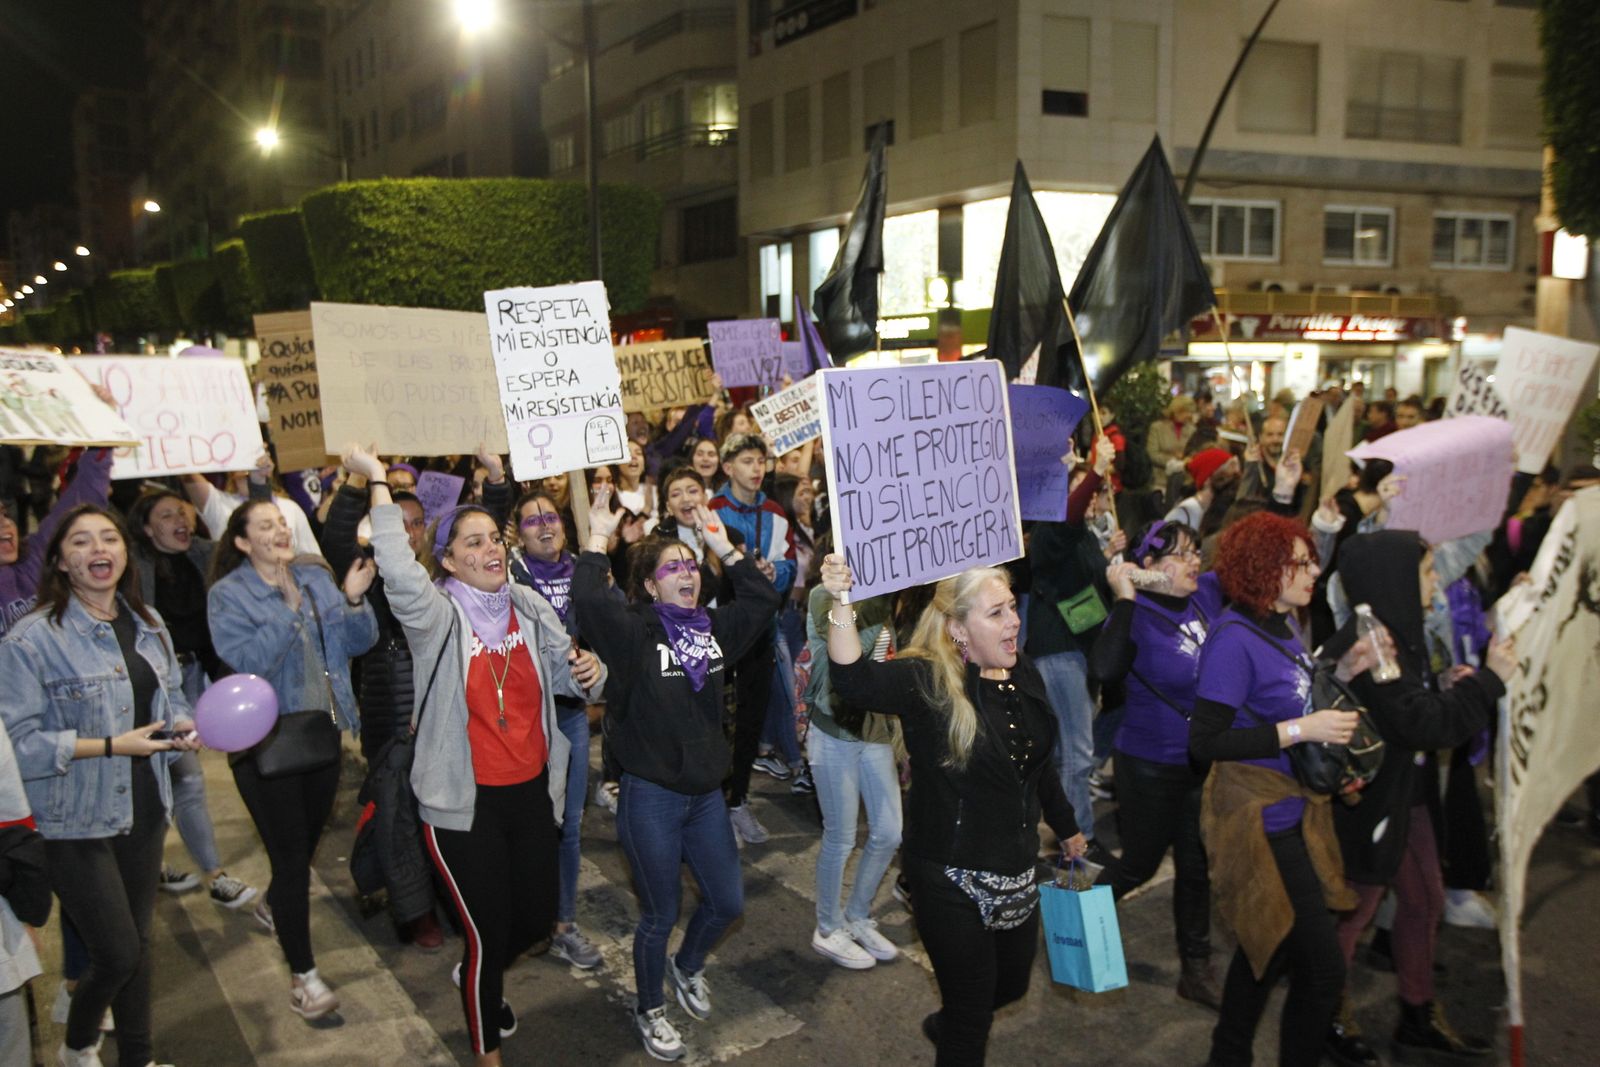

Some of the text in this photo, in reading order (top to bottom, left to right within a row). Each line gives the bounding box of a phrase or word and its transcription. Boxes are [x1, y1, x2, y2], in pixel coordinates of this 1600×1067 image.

[497, 298, 591, 325] RESPETA
[544, 351, 558, 367] O
[506, 368, 580, 392] ESPERA
[281, 411, 321, 431] NOM
[774, 399, 812, 425] BESTIA
[136, 430, 236, 470] IEDO
[836, 442, 873, 484] NO
[878, 434, 910, 479] ME
[840, 489, 874, 531] TU
[845, 541, 877, 592] NO
[870, 531, 900, 582] TE
